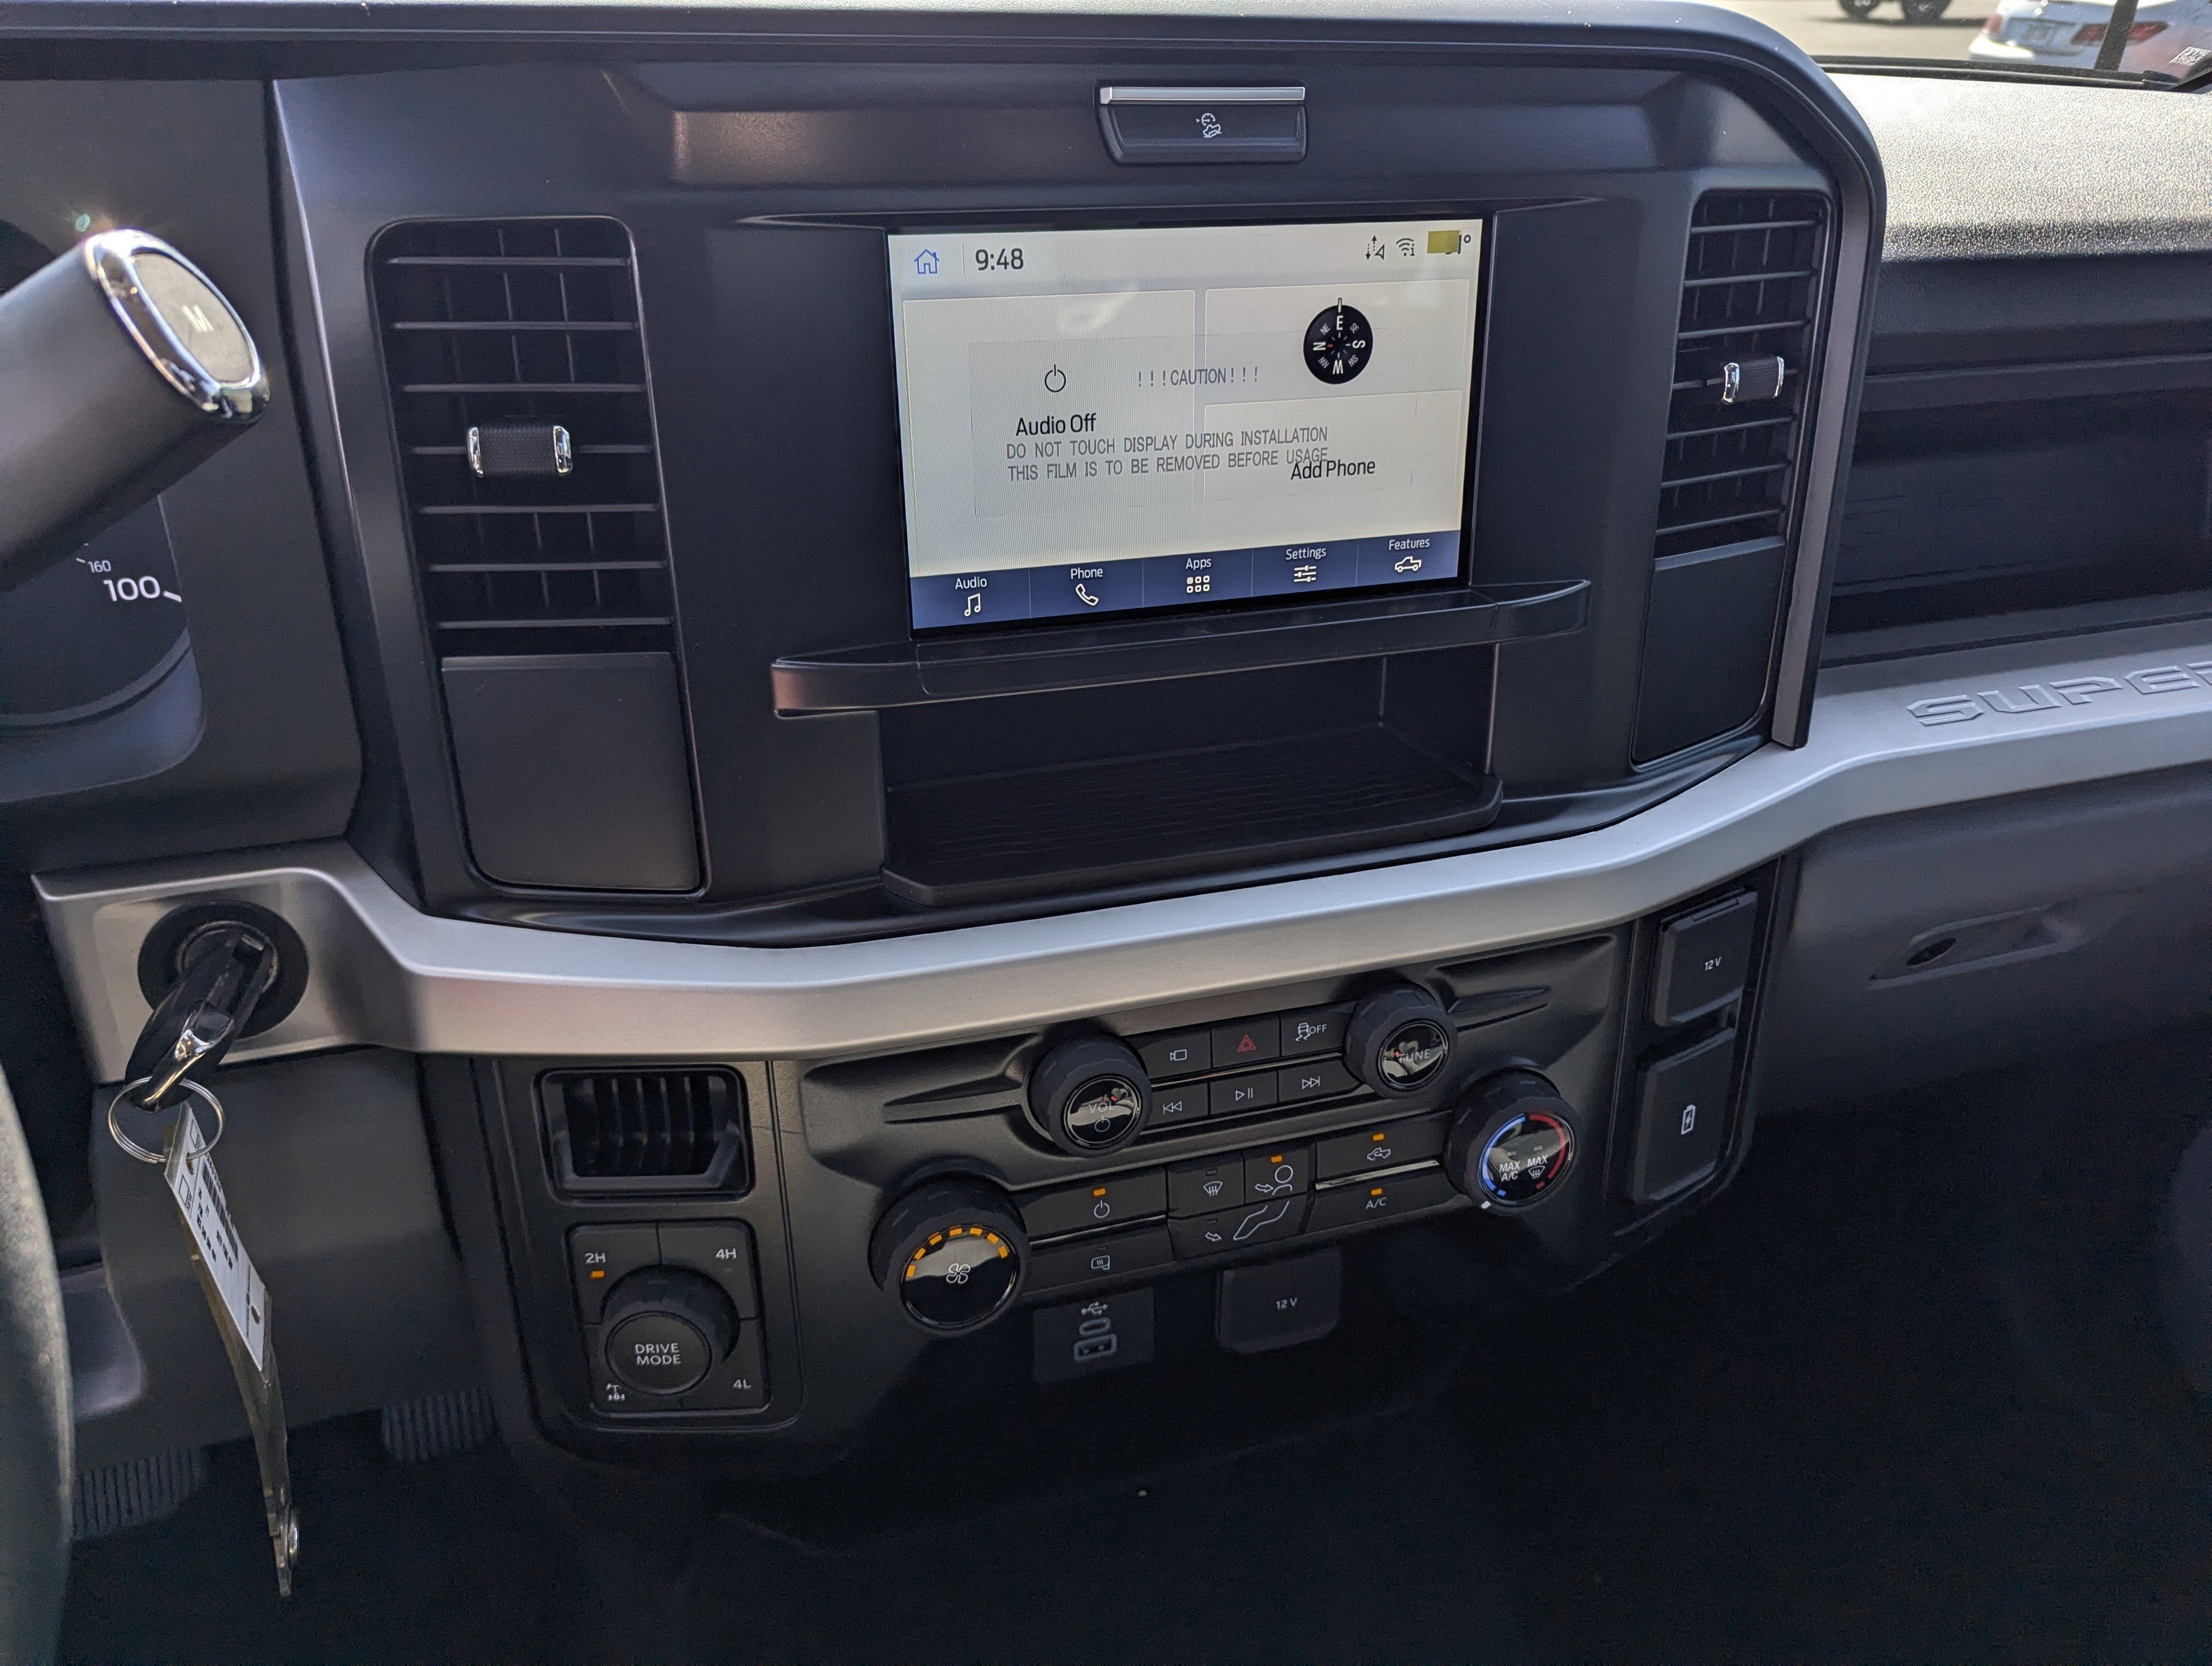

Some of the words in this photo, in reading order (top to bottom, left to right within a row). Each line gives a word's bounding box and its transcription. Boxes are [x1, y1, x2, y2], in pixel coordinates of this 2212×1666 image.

[975, 248, 1024, 271] 9:48
[1336, 316, 1343, 330] E
[1313, 341, 1326, 351] N
[1352, 340, 1366, 349] S
[1015, 415, 1066, 436] Audio
[1070, 412, 1097, 433] Off
[1006, 443, 1027, 459] DO
[1035, 441, 1062, 458] NOT
[1069, 438, 1115, 456] TOUCH
[1124, 434, 1178, 453] DISPLAY
[1185, 431, 1234, 449] DURING
[1240, 426, 1328, 446] INSTALLATION
[1008, 464, 1039, 482] THIS
[1046, 462, 1077, 479] FILM
[1084, 461, 1097, 477] IS
[1105, 459, 1123, 476] TO
[1130, 458, 1149, 475] BE
[1156, 454, 1220, 472] REMOVED
[1228, 450, 1279, 468] BEFORE
[1287, 447, 1328, 464] USAGE
[1290, 461, 1322, 480] Add
[1326, 458, 1375, 477] Phone
[1388, 537, 1430, 551] Features
[1285, 547, 1327, 561] Settings
[87, 560, 112, 573] 160
[1185, 558, 1212, 571] Apps
[1070, 567, 1103, 580] Phone
[102, 575, 160, 602] 100
[955, 576, 987, 590] Audio
[1705, 960, 1714, 970] 12
[1308, 1024, 1327, 1034] OFF
[1398, 1048, 1431, 1063] TUNE
[1088, 1100, 1115, 1114] VOL
[1499, 1161, 1521, 1173] MAX
[1527, 1155, 1548, 1167] MAX
[1500, 1171, 1519, 1182] A/C
[1365, 1197, 1387, 1209] A/C
[585, 1252, 606, 1264] 2H
[715, 1248, 737, 1260] 4H
[1276, 1300, 1288, 1309] 12
[1290, 1297, 1297, 1307] V
[635, 1342, 680, 1355] DRIVE
[636, 1354, 681, 1366] MODE
[733, 1379, 751, 1389] 4L
